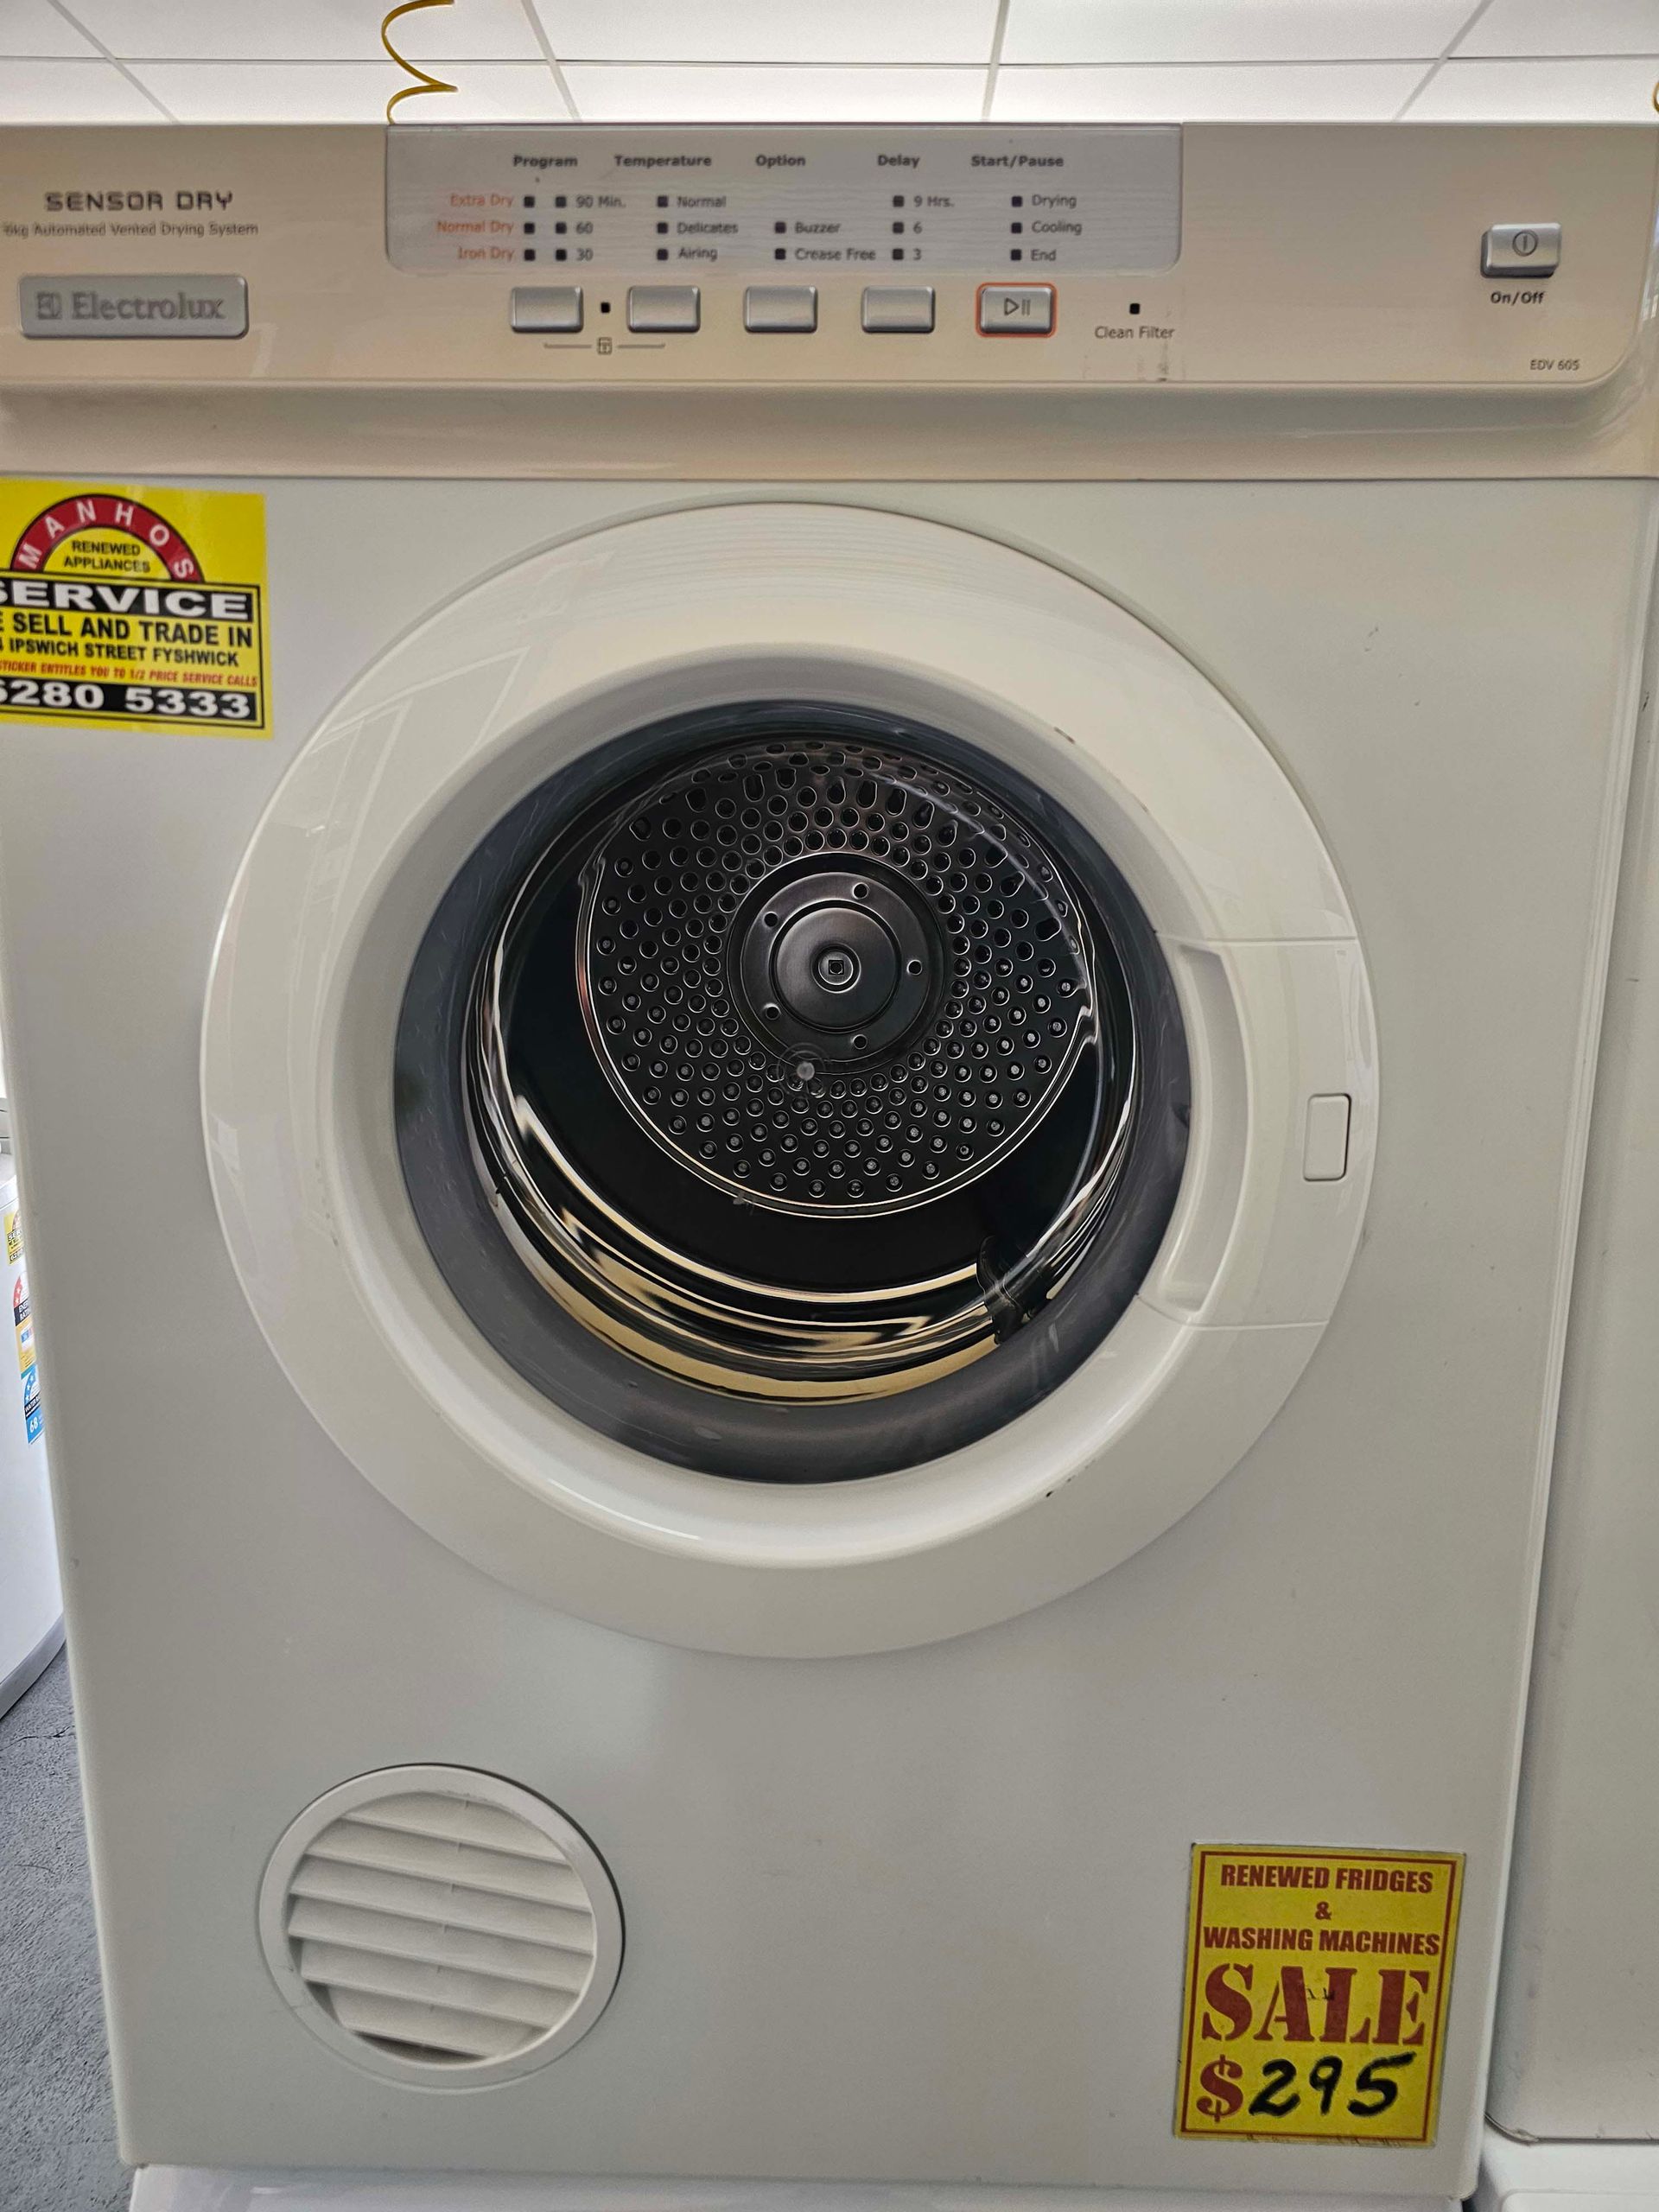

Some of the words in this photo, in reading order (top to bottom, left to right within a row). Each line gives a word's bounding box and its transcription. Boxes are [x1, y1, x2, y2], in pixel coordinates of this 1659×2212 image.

[513, 155, 578, 170] Program
[614, 155, 712, 169] Temperature
[755, 155, 806, 168] Option
[877, 154, 919, 168] Delay
[971, 154, 1064, 168] Start/Pause
[44, 191, 163, 212] SENSOR
[176, 191, 233, 212] DRY
[450, 193, 485, 208] Extra
[489, 193, 514, 210] Dry
[575, 194, 594, 209] 90
[598, 194, 626, 209] Min.
[677, 194, 727, 209] Normal
[913, 194, 923, 208] 9
[927, 194, 954, 208] Hrs.
[1032, 194, 1077, 210] Drying
[35, 222, 105, 237] Automated
[111, 223, 156, 237] Vented
[162, 224, 205, 238] Drying
[209, 223, 259, 238] System
[436, 219, 485, 234] Normal
[489, 219, 514, 237] Dry
[575, 221, 594, 235] 60
[677, 220, 739, 235] Delicates
[795, 220, 841, 235] Buzzer
[913, 221, 923, 235] 6
[1032, 220, 1083, 237] Cooling
[458, 245, 485, 261] Iron
[489, 245, 515, 263] Dry
[575, 248, 594, 262] 30
[678, 247, 718, 263] Airing
[795, 247, 842, 262] Crease
[846, 247, 876, 262] Free
[913, 247, 922, 262] 3
[1031, 247, 1057, 262] End
[71, 291, 226, 320] Electrolux
[1491, 290, 1545, 306] On/Off
[1094, 325, 1134, 339] Clean
[1139, 325, 1175, 339] Filter
[1530, 359, 1554, 371] EDV
[1558, 359, 1580, 371] 605
[17, 499, 195, 579] MANHOS
[72, 539, 141, 557] RENEWED
[63, 556, 151, 574] APPLIANCES
[0, 580, 249, 620] ERVICE
[13, 612, 73, 636] SELL
[80, 617, 130, 640] AND
[139, 620, 219, 645] TRADE
[229, 626, 252, 648] IN
[10, 637, 79, 658] IPSWICH
[85, 642, 148, 662] STREET
[153, 646, 239, 667] FYSHWICK
[41, 663, 86, 677] ENTITLES
[91, 664, 110, 679] YOU
[113, 668, 126, 680] TO
[149, 670, 178, 683] PRICE
[182, 673, 224, 686] SERVICE
[227, 675, 257, 688] CALLS
[125, 686, 251, 720] 5333
[1220, 1864, 1331, 1890] RENEWED
[1335, 1867, 1433, 1894] FRIDGES
[1314, 1901, 1332, 1921] &
[1203, 1926, 1313, 1951] WASHING
[1319, 1929, 1441, 1956] MACHINES
[1201, 1962, 1431, 2046] SALE
